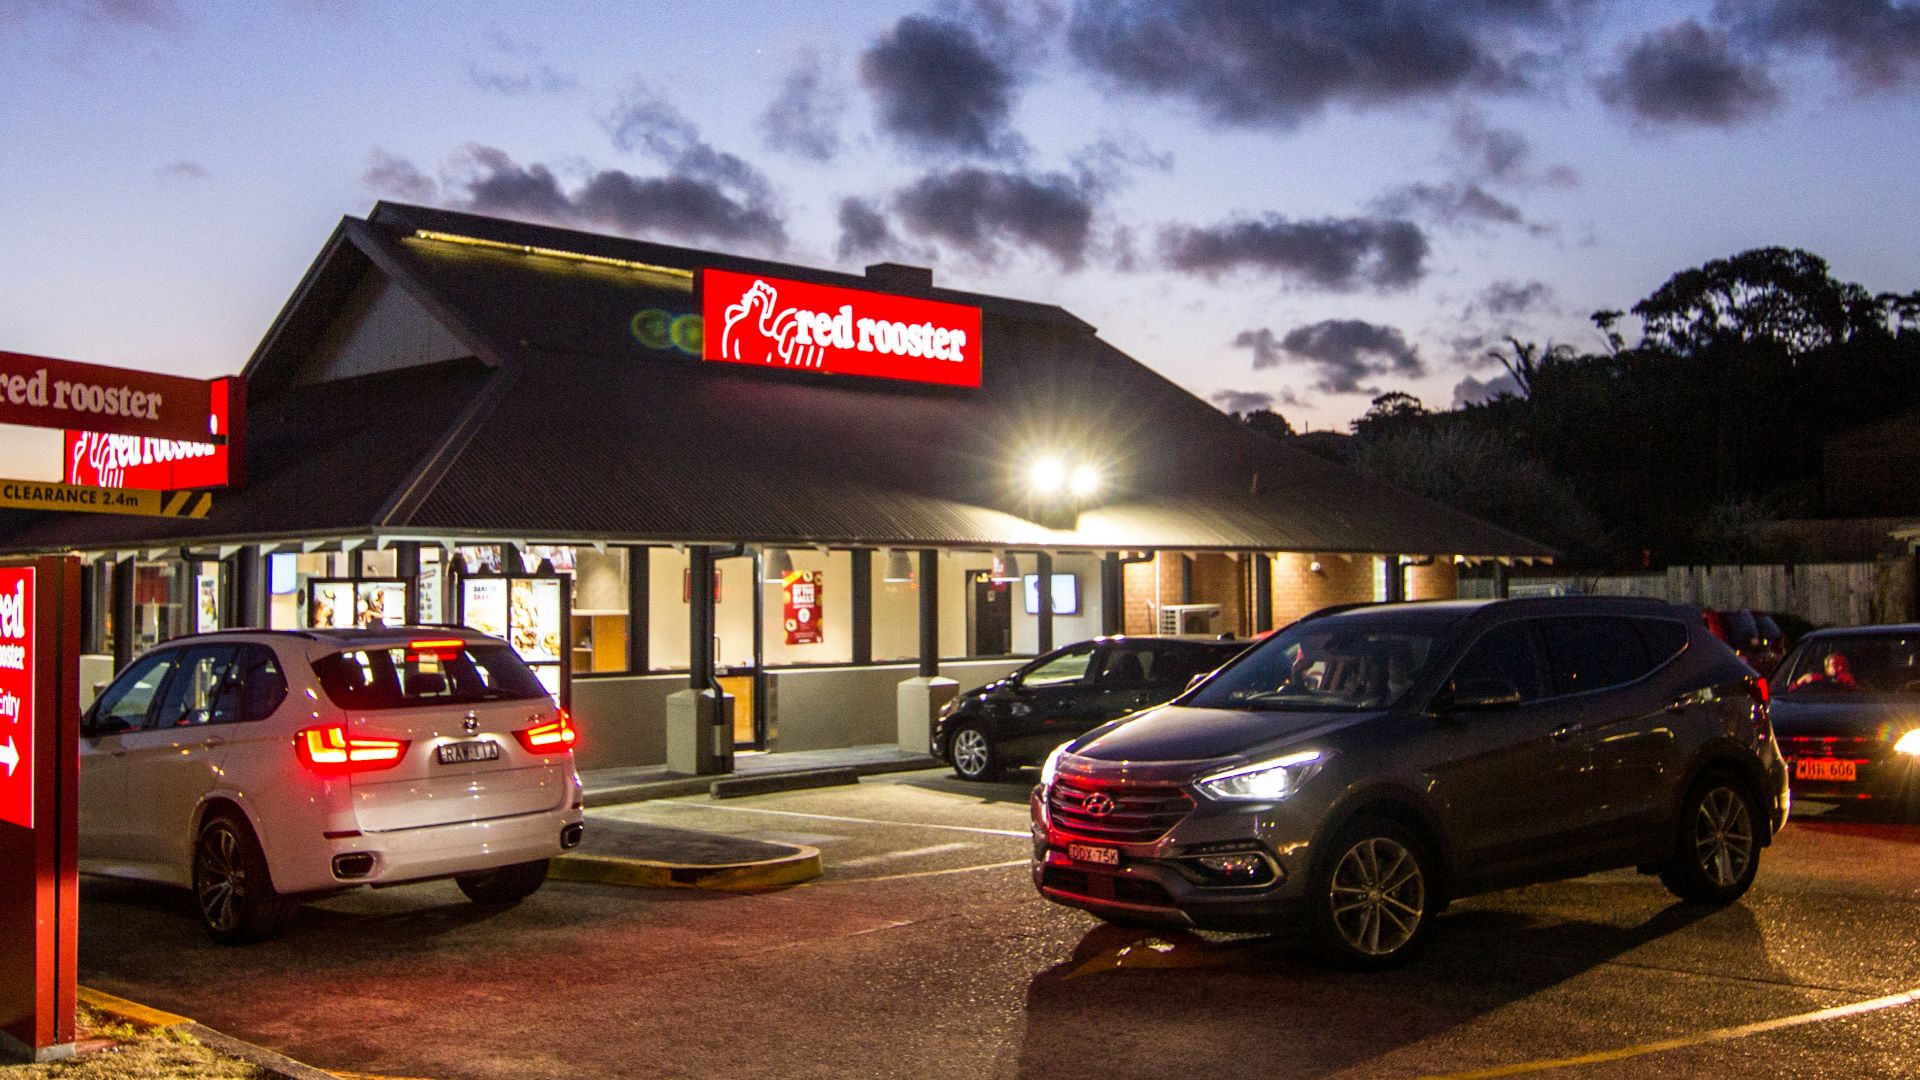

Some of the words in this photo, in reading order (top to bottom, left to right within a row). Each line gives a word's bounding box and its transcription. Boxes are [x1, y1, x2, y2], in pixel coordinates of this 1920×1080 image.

[793, 304, 855, 349] red
[856, 317, 967, 362] rooster
[53, 380, 163, 420] rooster
[3, 484, 97, 505] CLEARANCE
[102, 492, 139, 507] 2.4m
[1829, 763, 1854, 777] 606
